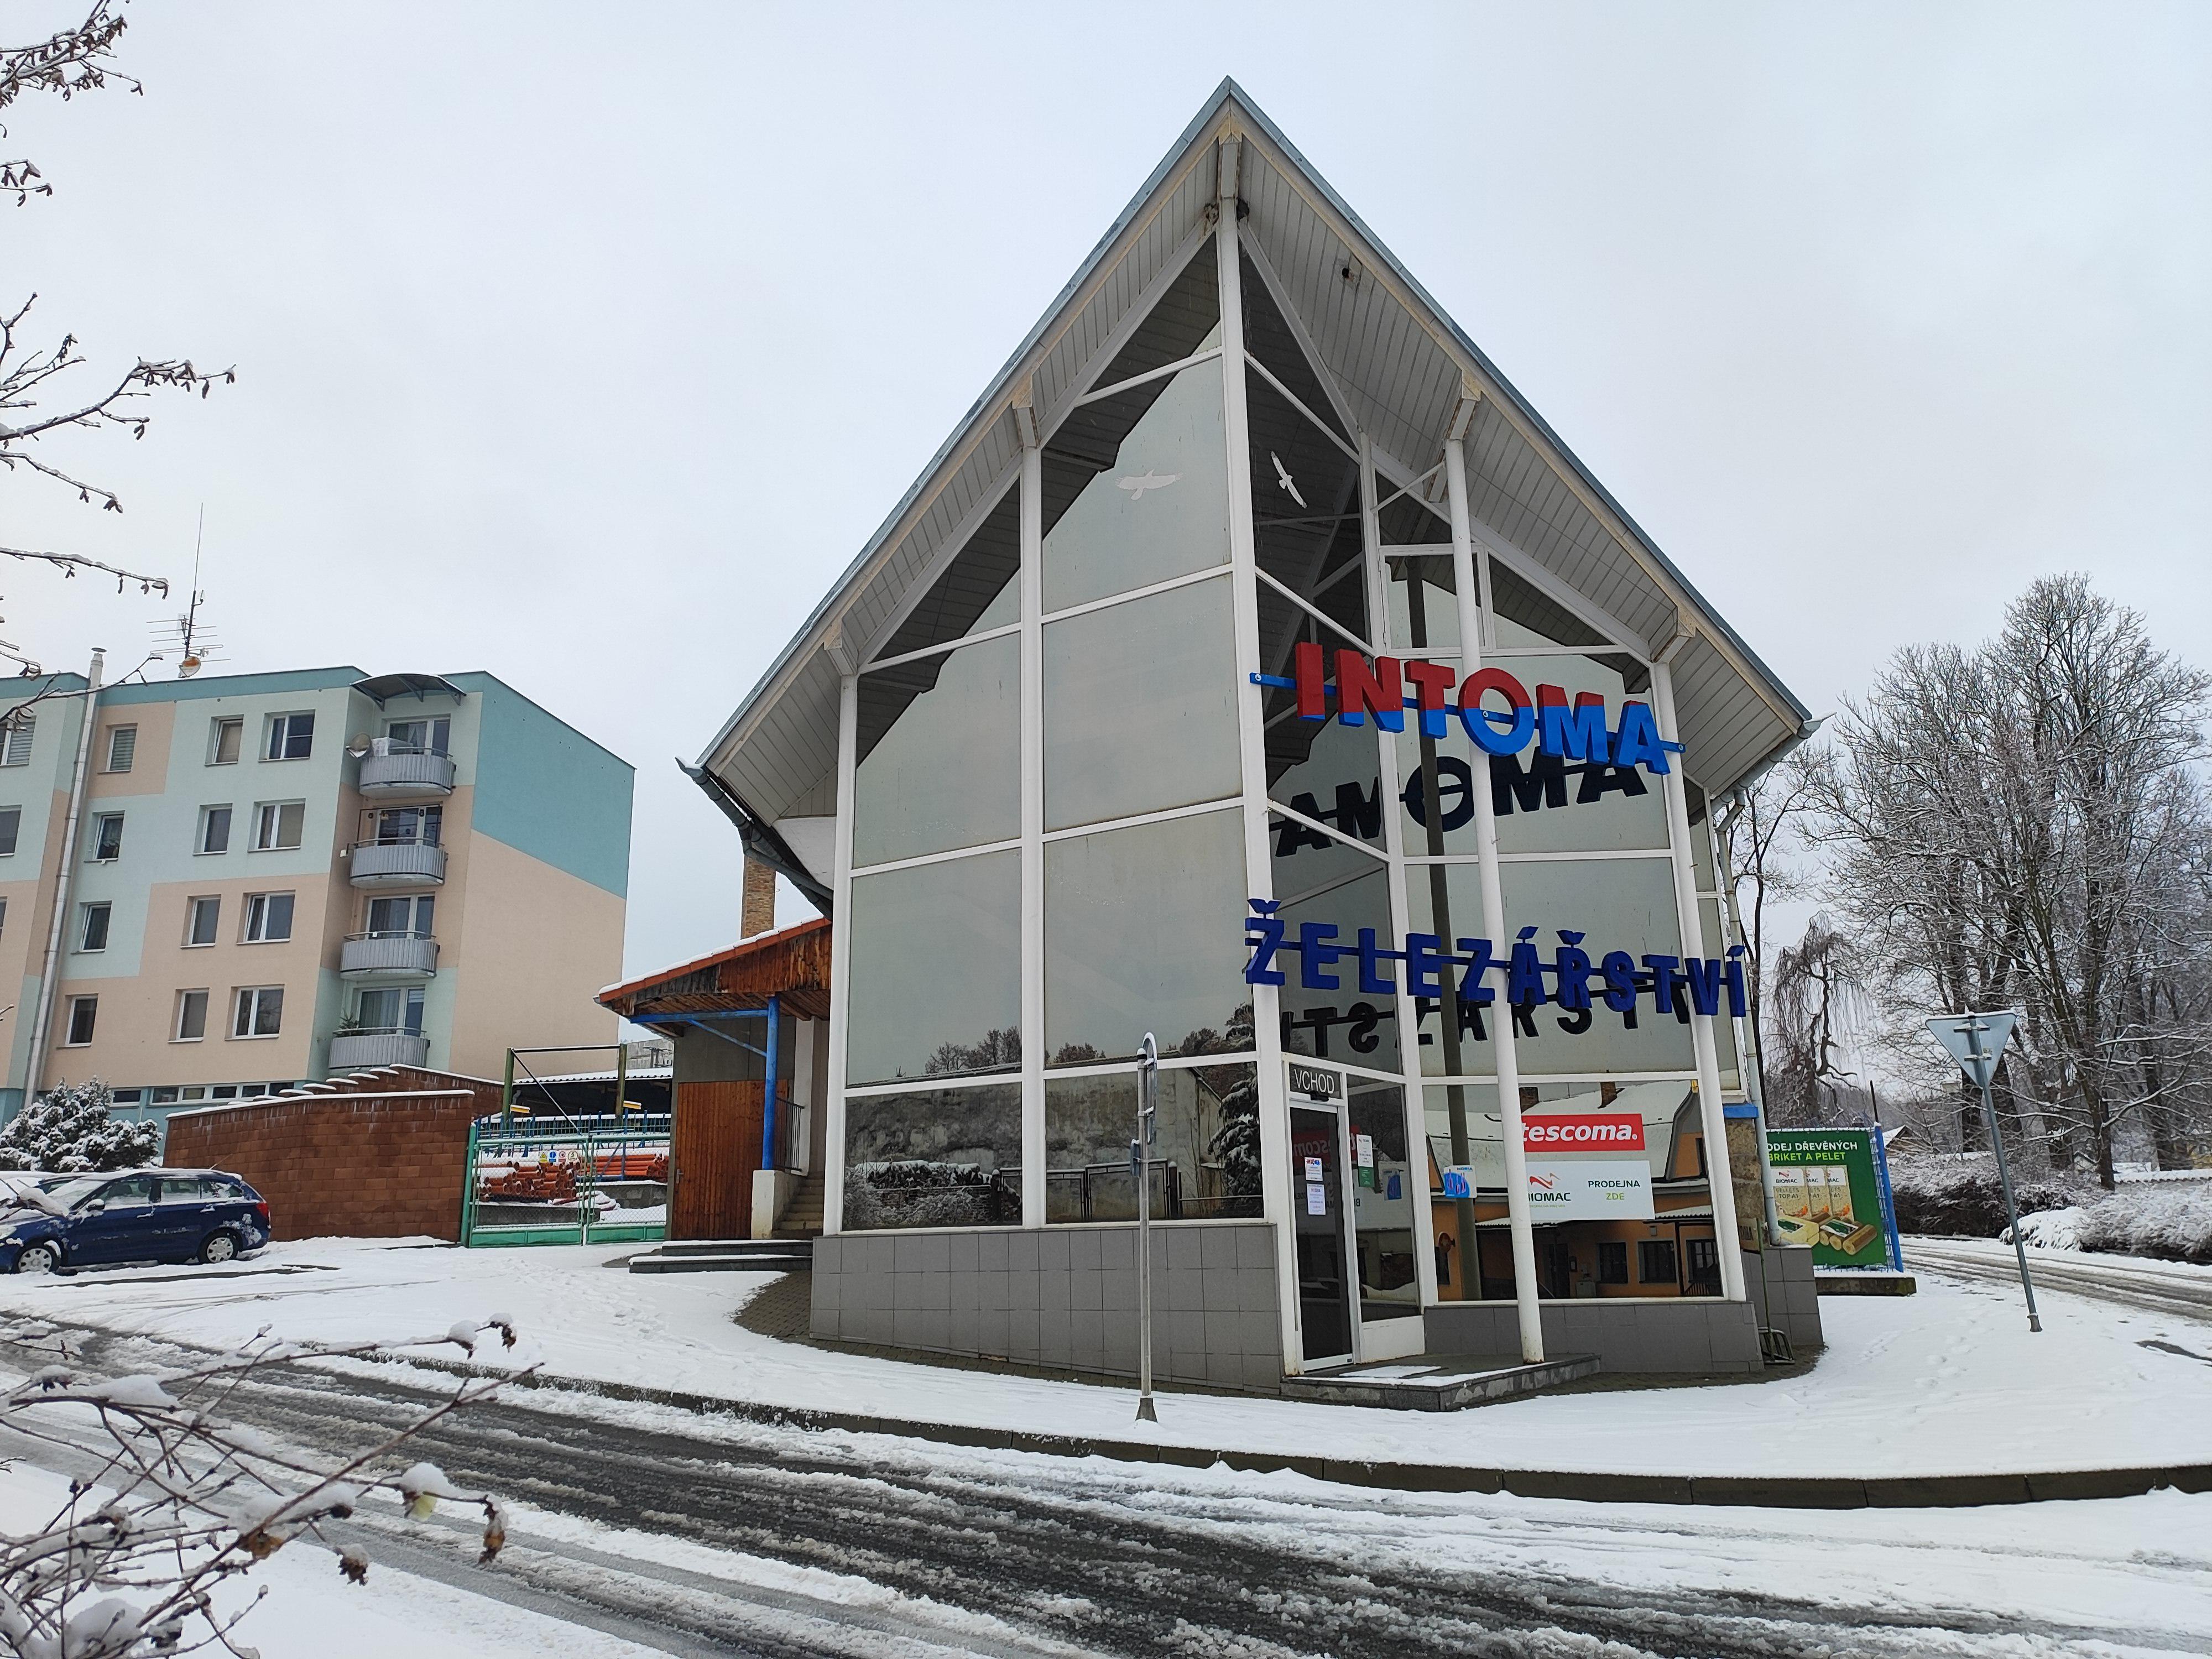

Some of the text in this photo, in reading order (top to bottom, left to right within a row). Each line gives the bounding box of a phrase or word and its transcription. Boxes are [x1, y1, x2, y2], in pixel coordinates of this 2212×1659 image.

[1296, 642, 1670, 775] INTOMA
[1245, 898, 1746, 1017] ŽELEZÁŘSTVÍ
[1293, 1068, 1334, 1094] VCHOD
[1769, 1152, 1846, 1161] BRIKET A PELET
[1795, 1140, 1858, 1151] DŘEVĚNÝCH
